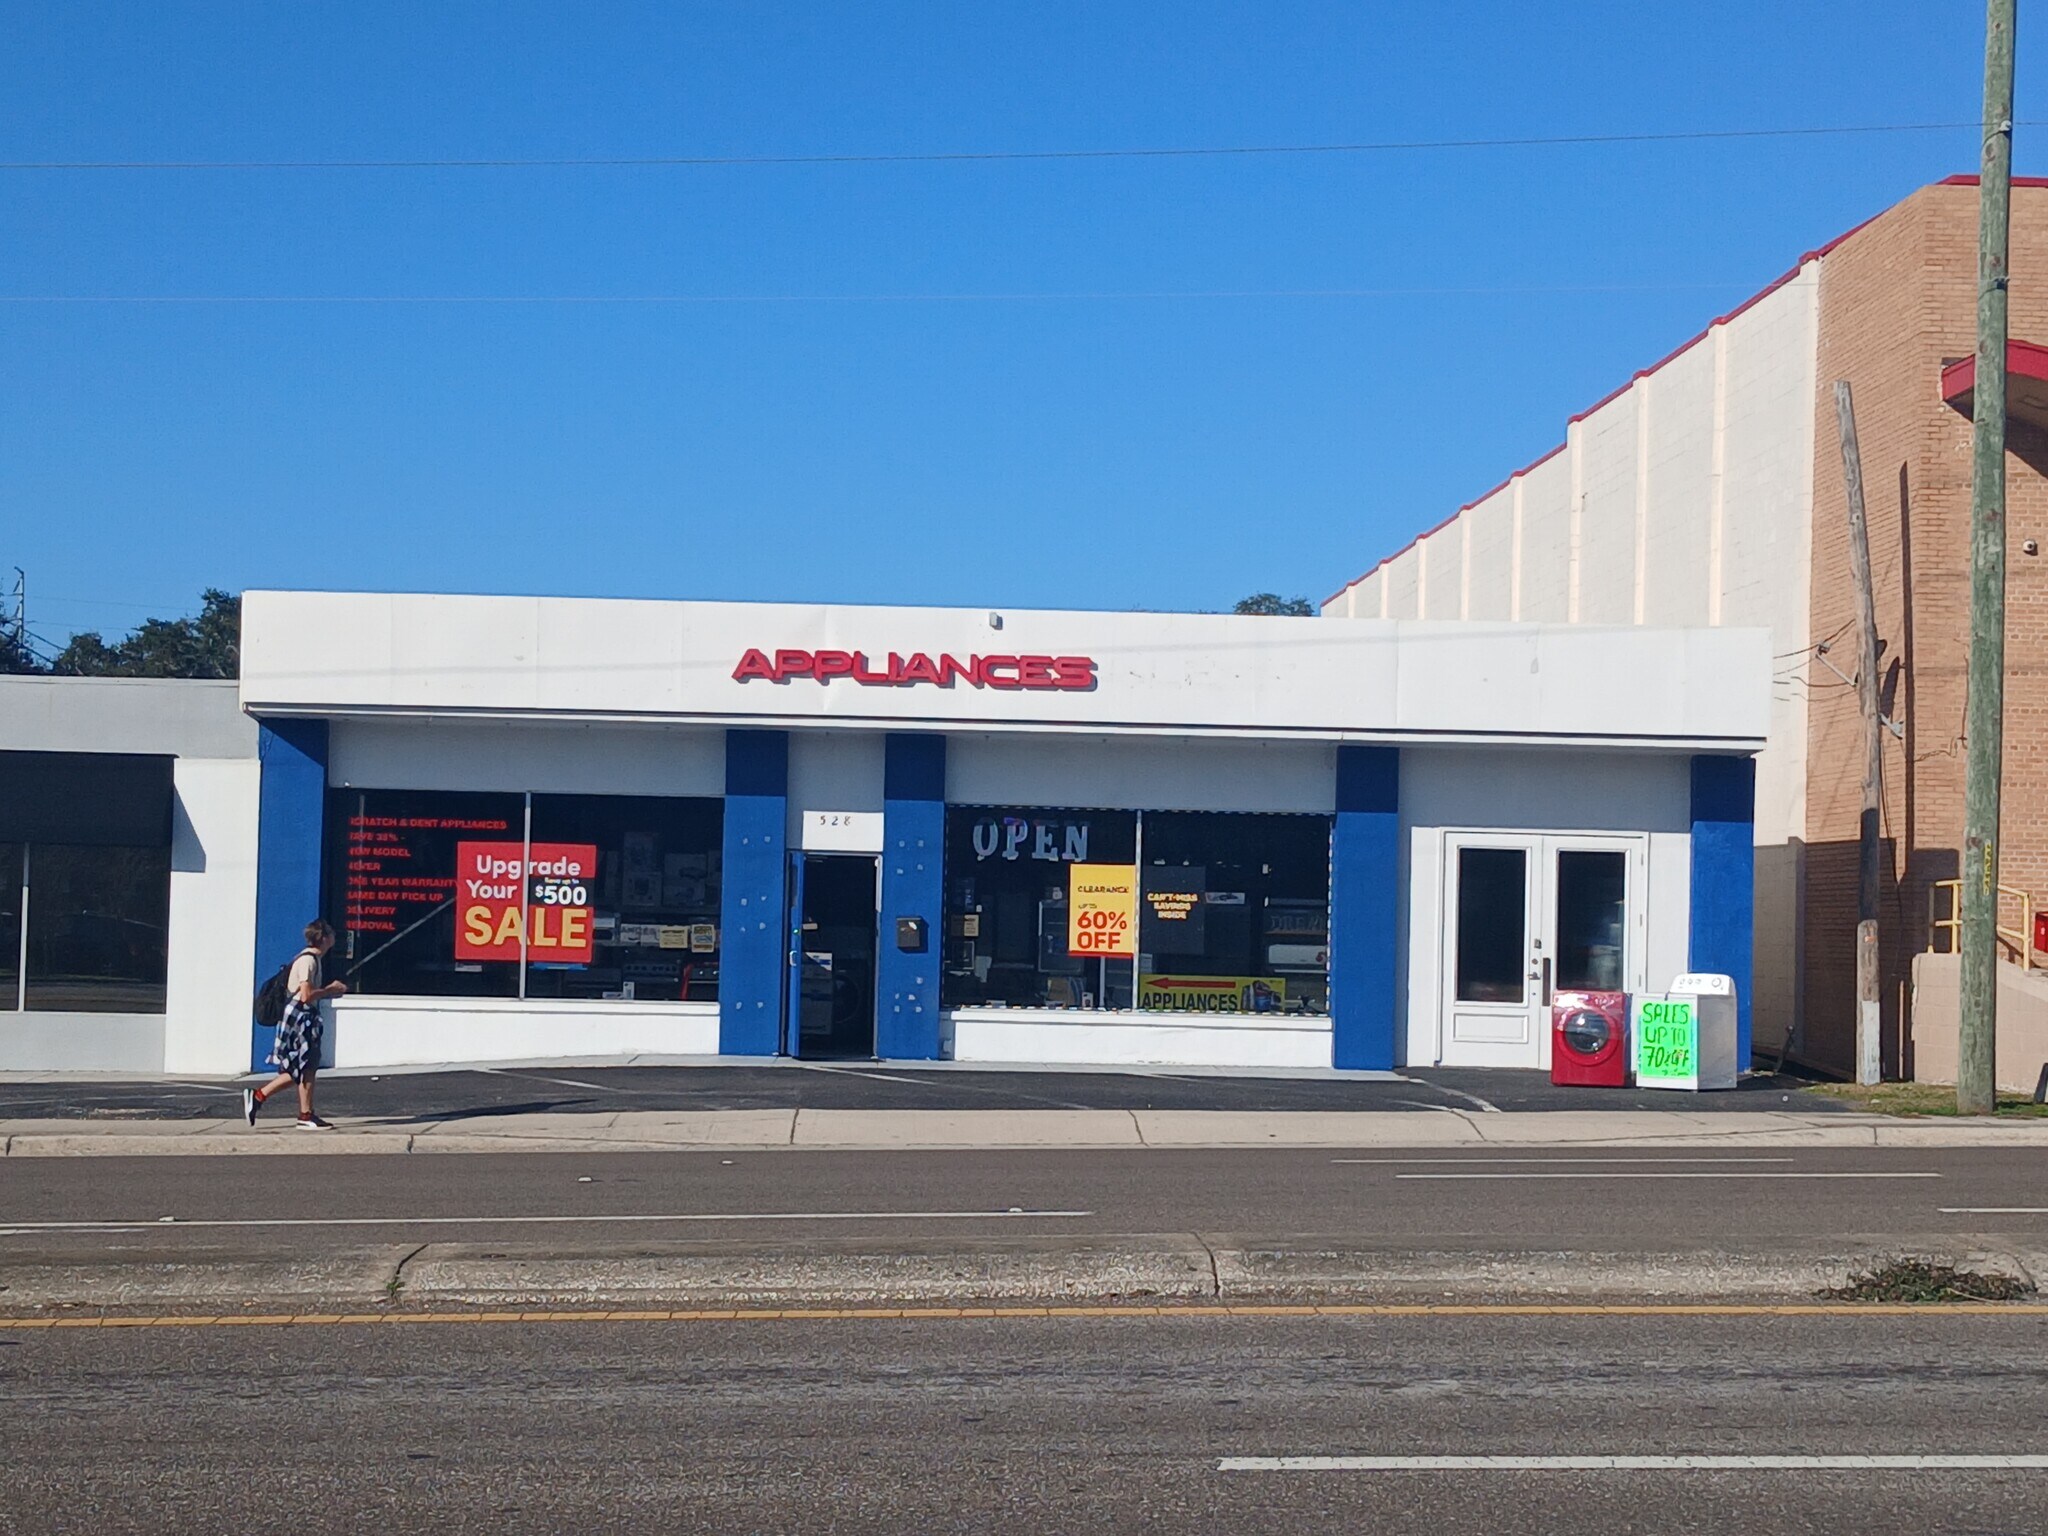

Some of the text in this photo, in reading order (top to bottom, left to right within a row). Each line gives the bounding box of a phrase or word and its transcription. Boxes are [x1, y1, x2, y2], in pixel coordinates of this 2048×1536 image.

[732, 648, 1098, 692] APPLIANCES
[410, 818, 438, 828] DENT
[440, 819, 507, 829] APPLIANCES
[820, 814, 851, 826] 528
[973, 818, 1087, 862] OPEN
[373, 848, 411, 857] MODEL
[477, 855, 581, 880] Upgrade
[371, 878, 399, 886] YEAR
[466, 880, 518, 899] Your
[378, 892, 399, 900] DAY
[401, 893, 427, 901] PICK
[429, 894, 443, 902] UP
[535, 885, 587, 905] $500
[464, 905, 588, 948] SALE
[1077, 911, 1127, 930] 60%
[1077, 931, 1121, 950] OFF
[1141, 992, 1238, 1011] APPLIANCES
[1642, 1002, 1690, 1025] SALES
[1645, 1026, 1686, 1047] UP TO
